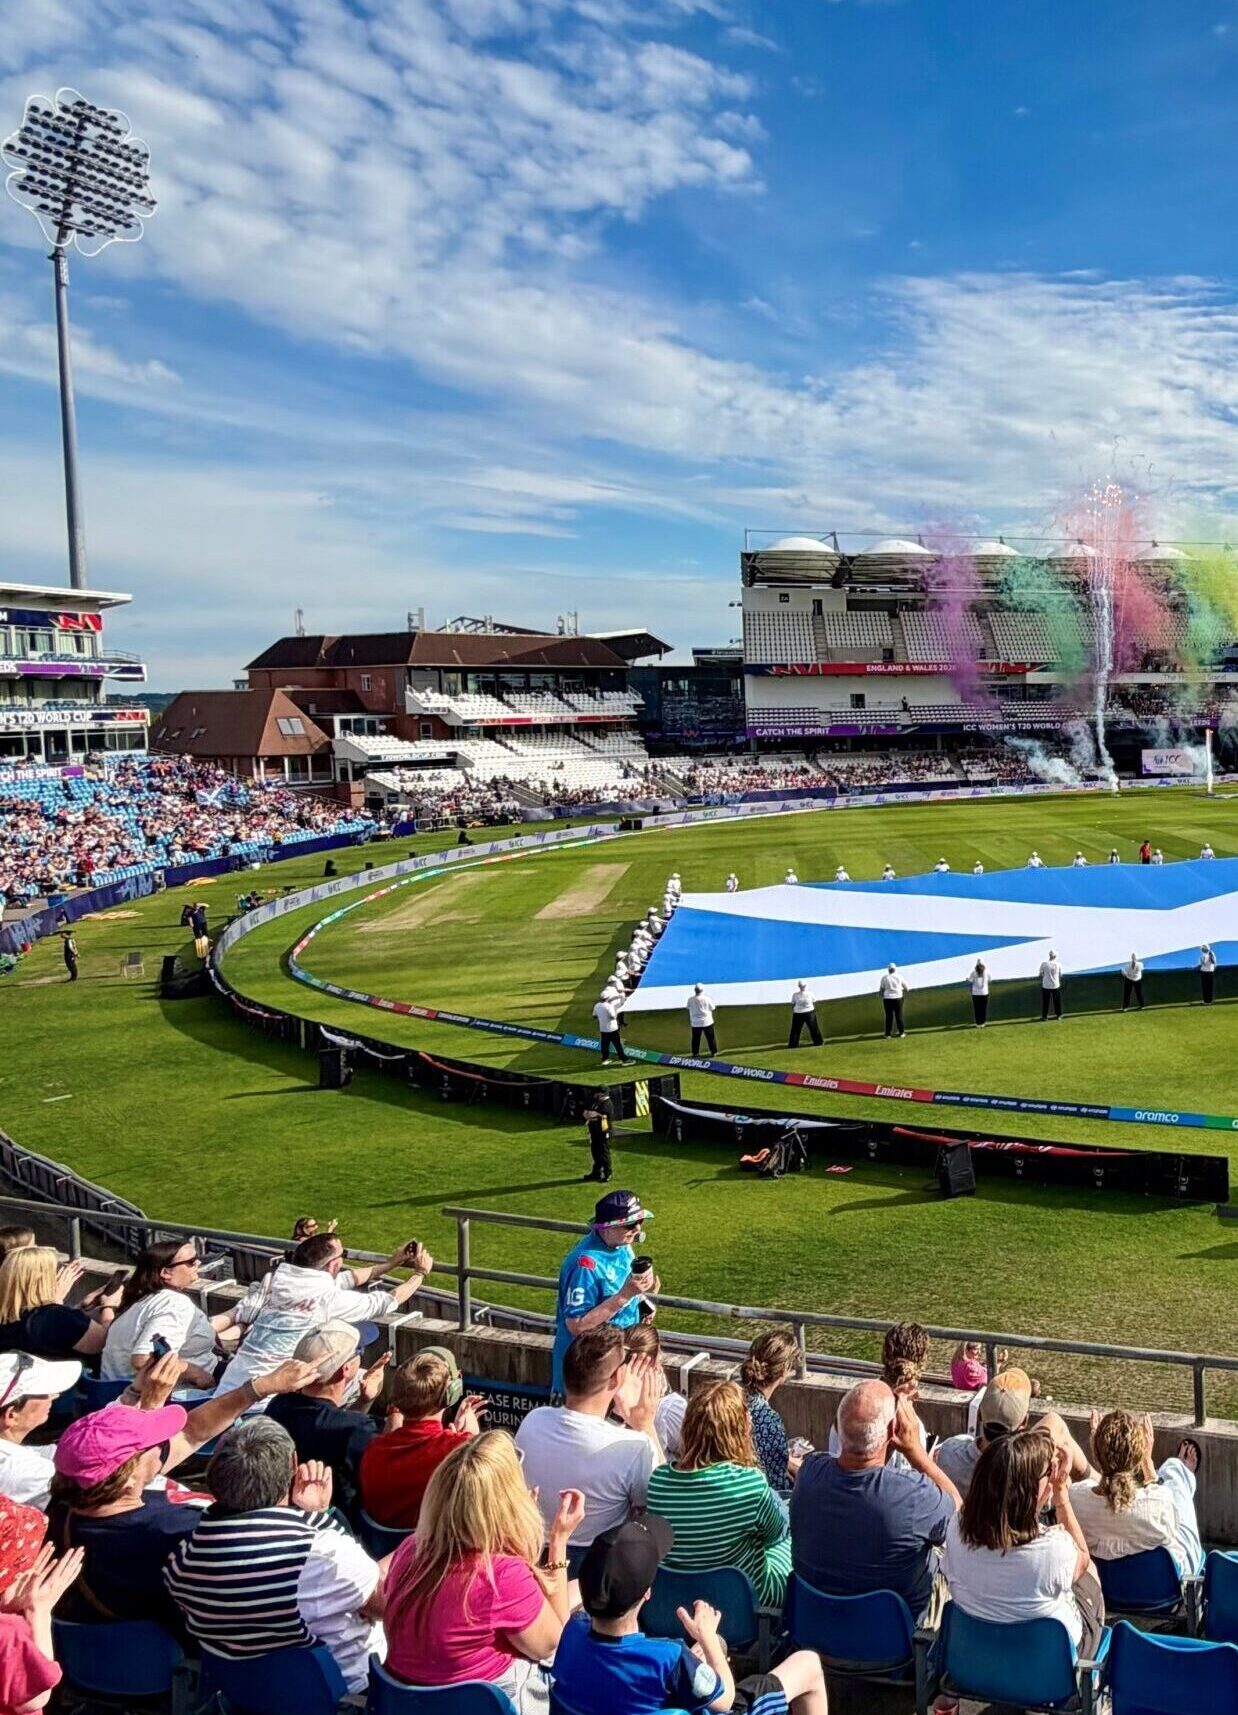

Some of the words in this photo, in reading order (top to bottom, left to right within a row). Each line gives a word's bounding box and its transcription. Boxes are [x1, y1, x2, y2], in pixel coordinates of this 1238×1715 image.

[866, 664, 904, 672] ENGLAND
[912, 664, 938, 672] WALES
[37, 711, 72, 723] WORLD
[73, 711, 93, 722] CUP
[755, 728, 785, 736] CATCH
[786, 727, 803, 735] THE
[804, 727, 831, 735] SPIRIT
[1033, 722, 1061, 730] WORLD
[16, 769, 34, 780] THE
[35, 768, 62, 779] SPIRIT
[669, 1056, 685, 1066] DP
[685, 1058, 711, 1070] WORLD
[731, 1065, 748, 1076] DP
[745, 1067, 774, 1080] WORLD
[803, 1075, 839, 1090] Emirates
[875, 1085, 914, 1100] Emirates
[1134, 1110, 1179, 1123] aramco
[566, 1287, 585, 1306] IG
[485, 1410, 524, 1426] DURIN
